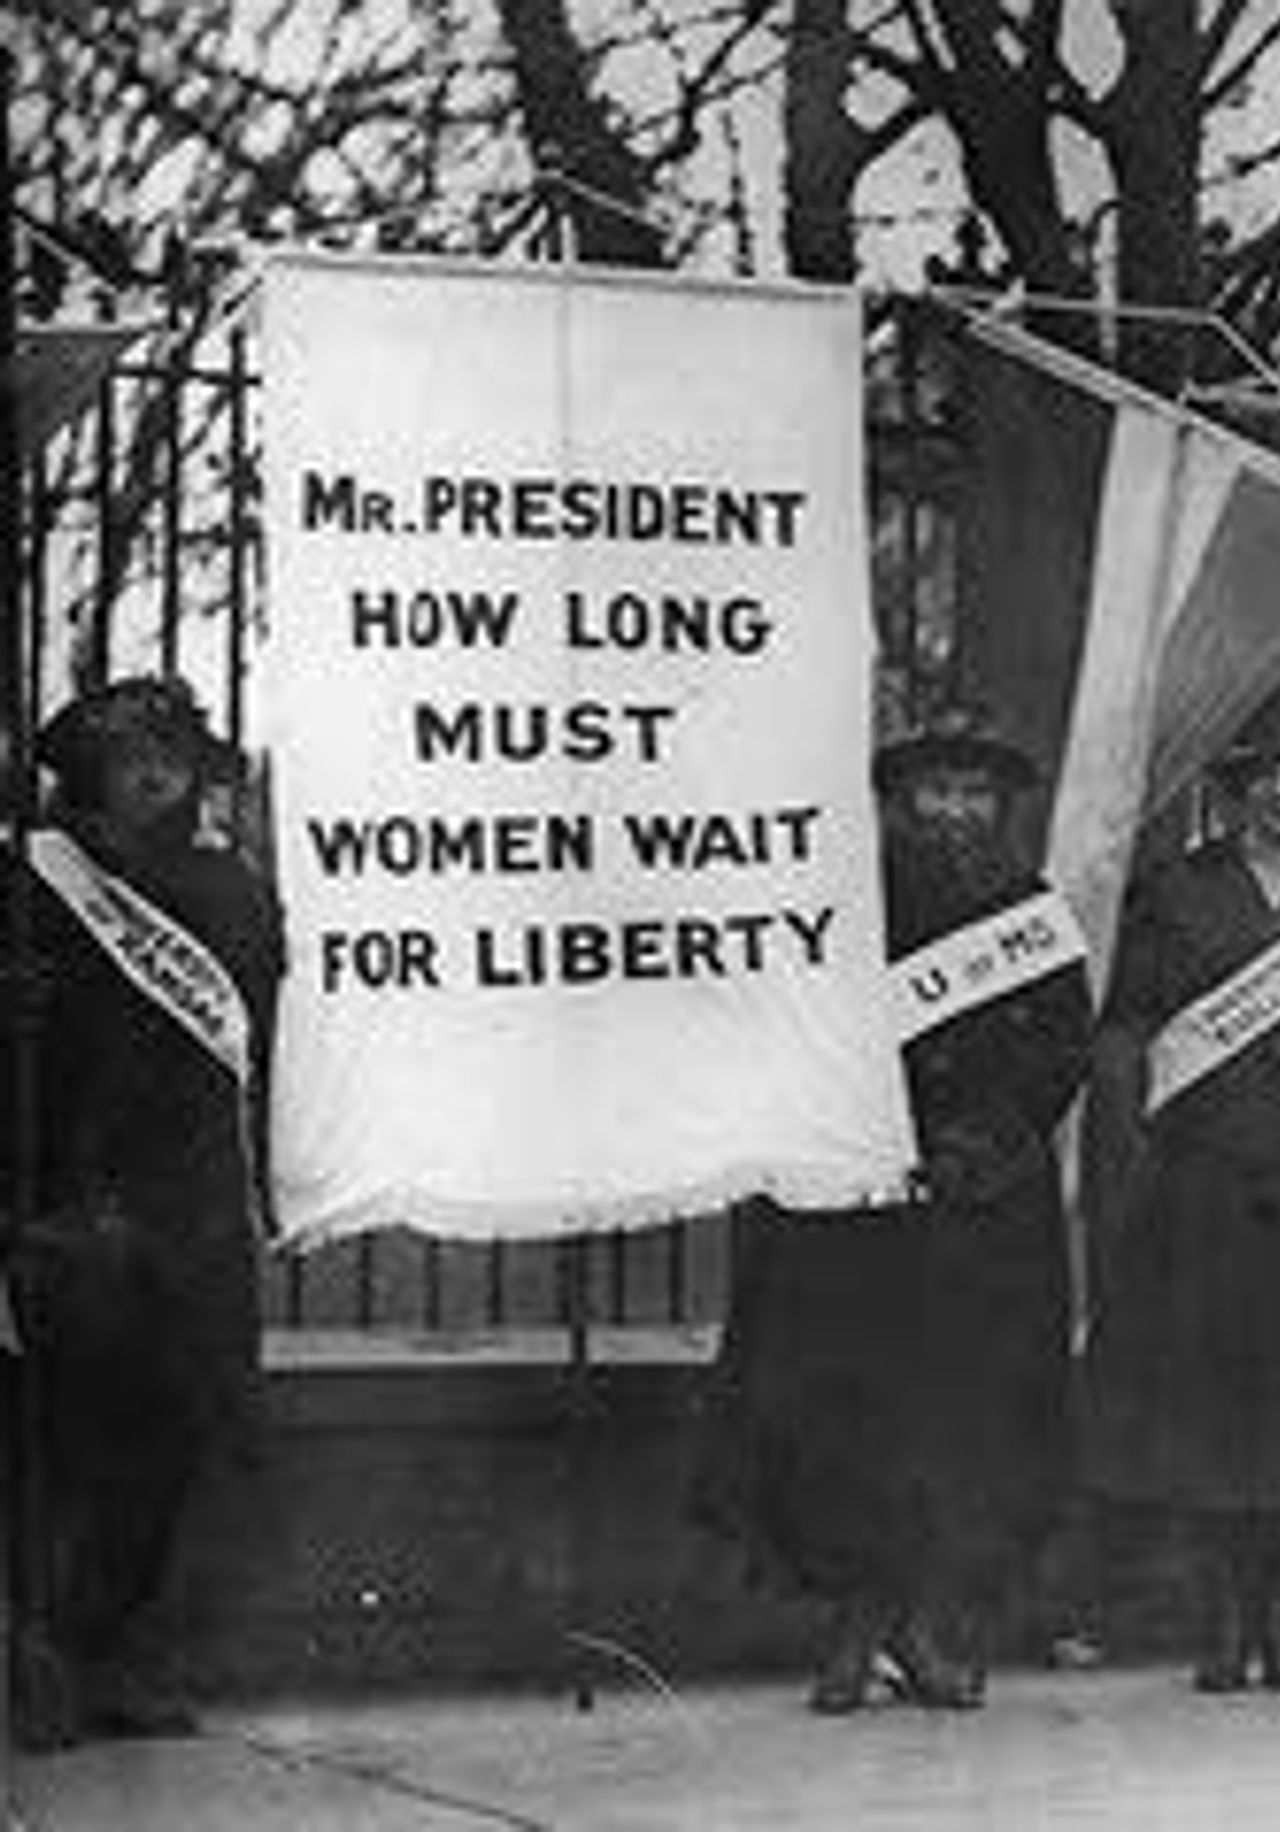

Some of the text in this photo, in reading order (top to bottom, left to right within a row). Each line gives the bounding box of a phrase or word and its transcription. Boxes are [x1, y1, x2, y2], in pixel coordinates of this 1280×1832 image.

[302, 471, 808, 548] MR. PRESIDENT
[352, 590, 774, 656] HOW LONG
[415, 701, 677, 763] MUST
[307, 806, 822, 877] WOMEN WAIT
[322, 906, 835, 993] FOR LIBERTY
[908, 967, 949, 1003] U
